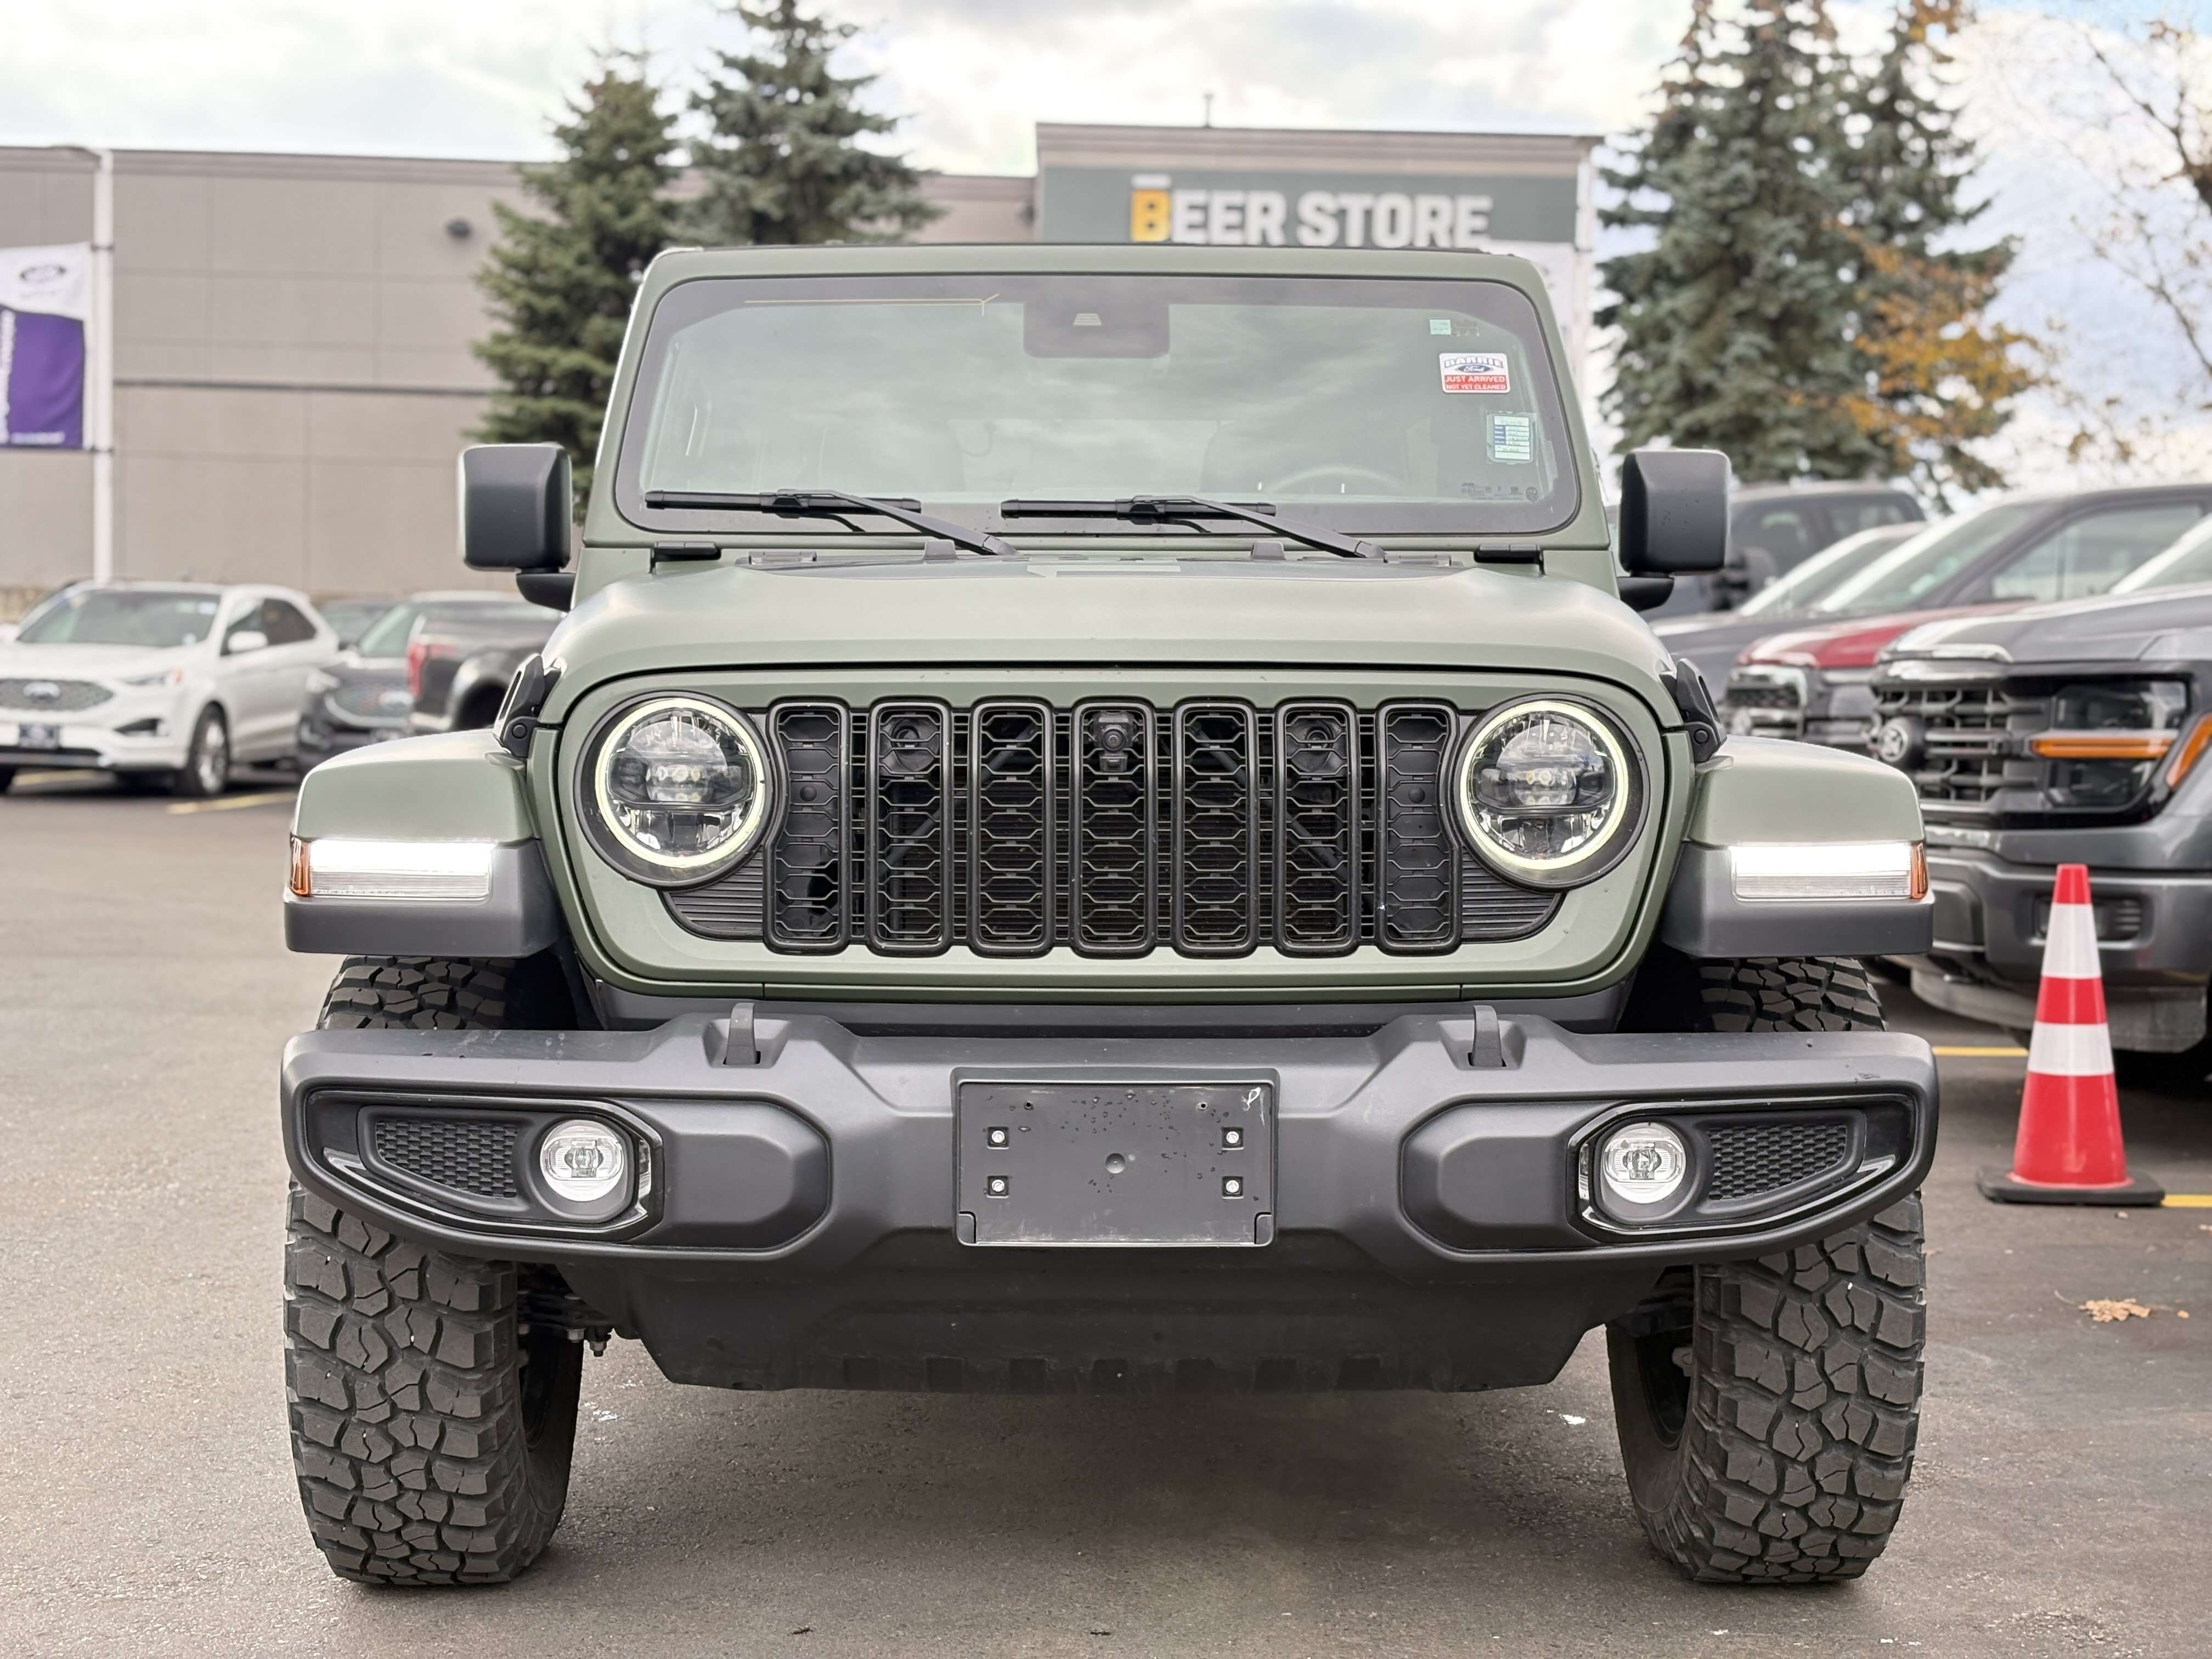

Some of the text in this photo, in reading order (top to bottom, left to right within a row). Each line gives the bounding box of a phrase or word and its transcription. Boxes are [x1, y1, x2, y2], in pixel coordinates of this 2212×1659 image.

[1131, 190, 1492, 249] BEER STORE
[1444, 356, 1503, 368] BARRIE
